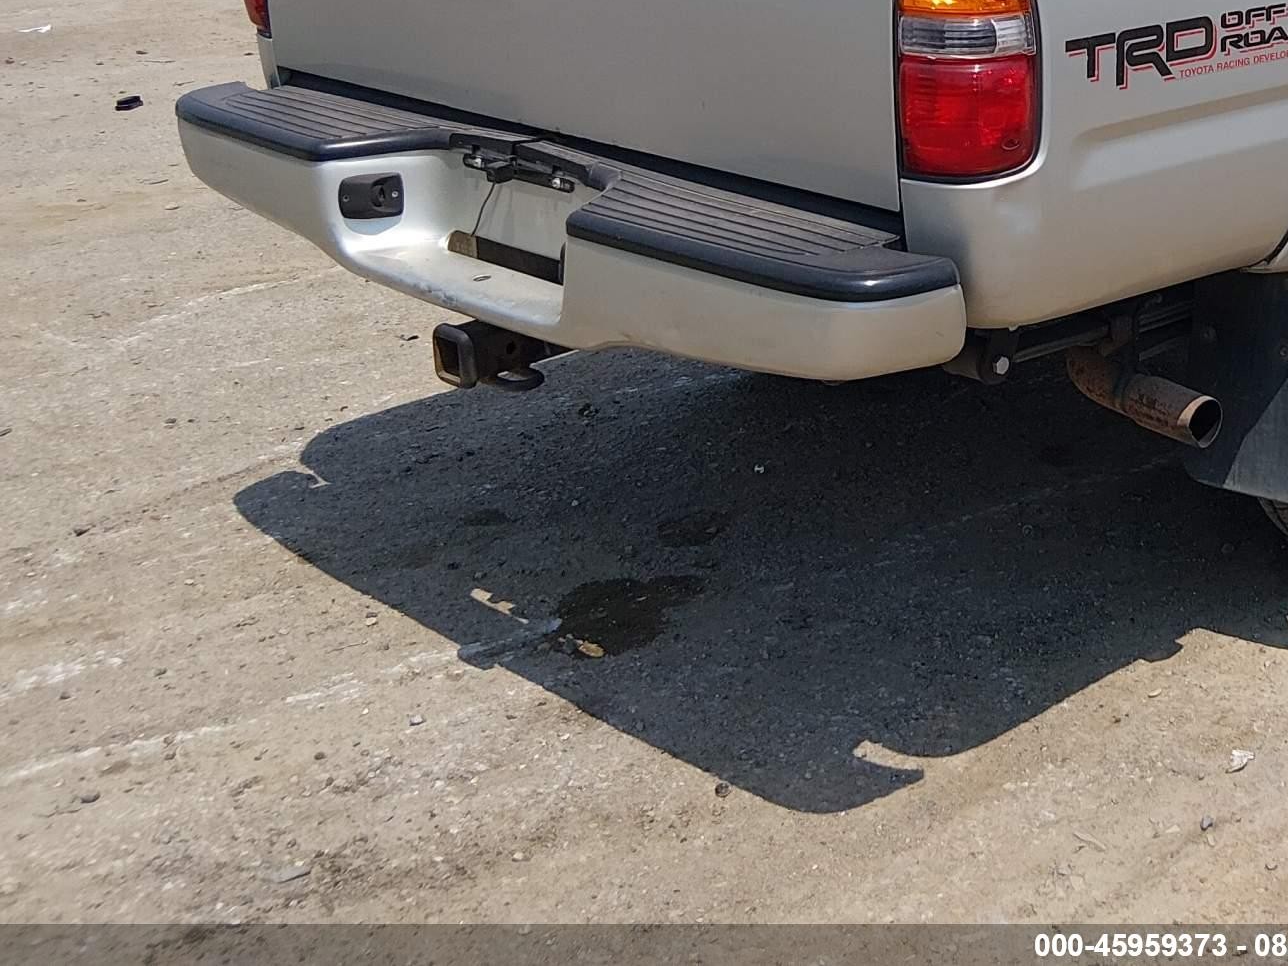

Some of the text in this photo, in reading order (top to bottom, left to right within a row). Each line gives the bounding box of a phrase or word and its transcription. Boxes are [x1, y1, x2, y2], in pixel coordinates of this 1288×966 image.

[1065, 16, 1217, 90] TRD
[1179, 66, 1215, 79] TOYOTA
[1216, 58, 1251, 72] RACING
